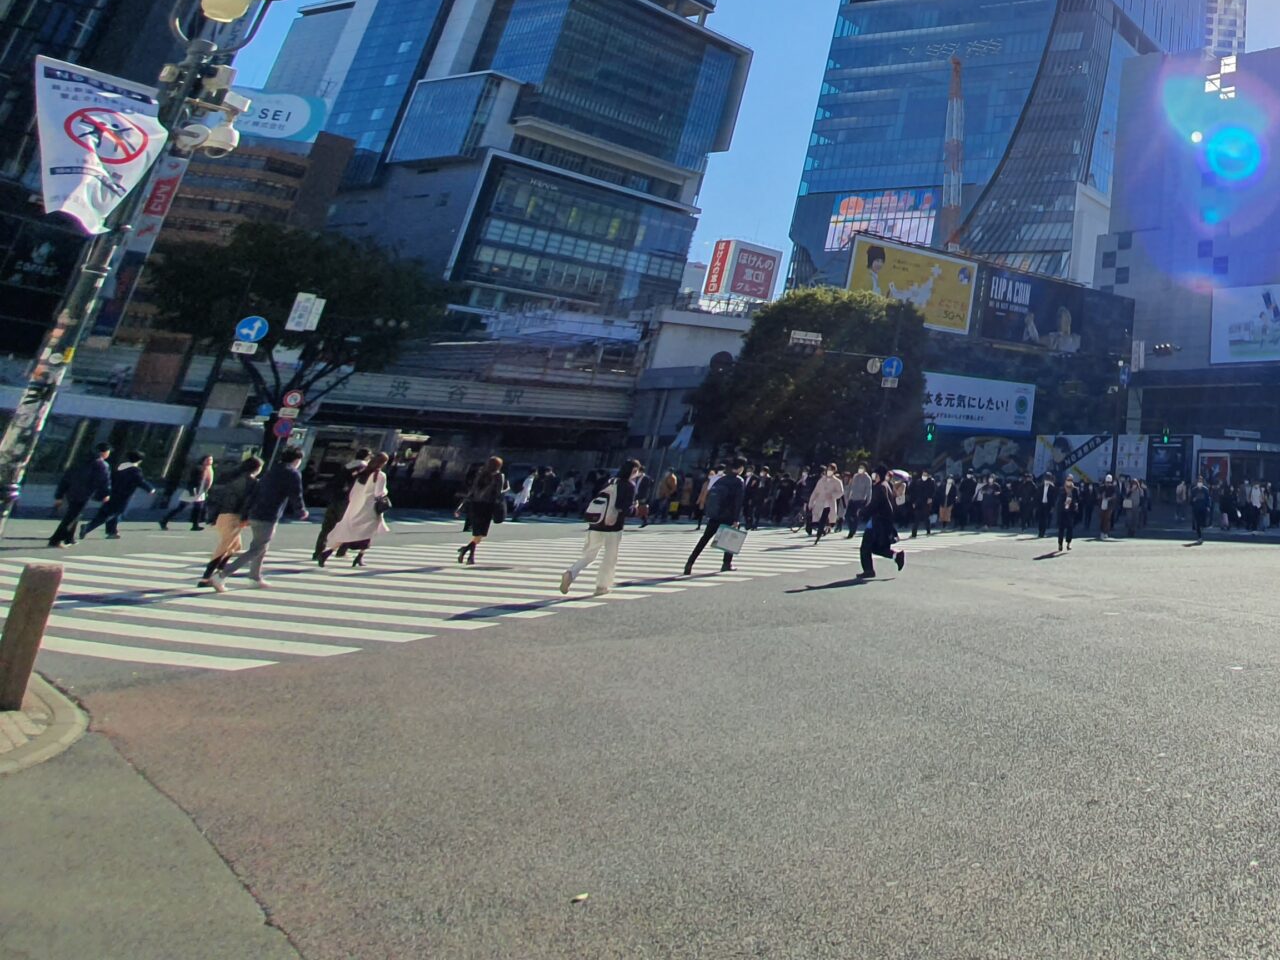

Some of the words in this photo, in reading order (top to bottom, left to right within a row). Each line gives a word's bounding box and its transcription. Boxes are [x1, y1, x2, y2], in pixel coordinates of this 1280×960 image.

[738, 251, 774, 271] ほけんの
[990, 275, 1007, 301] FLIP
[1006, 280, 1013, 302] A
[1013, 281, 1032, 305] COIN
[387, 377, 525, 405] 渋谷駅
